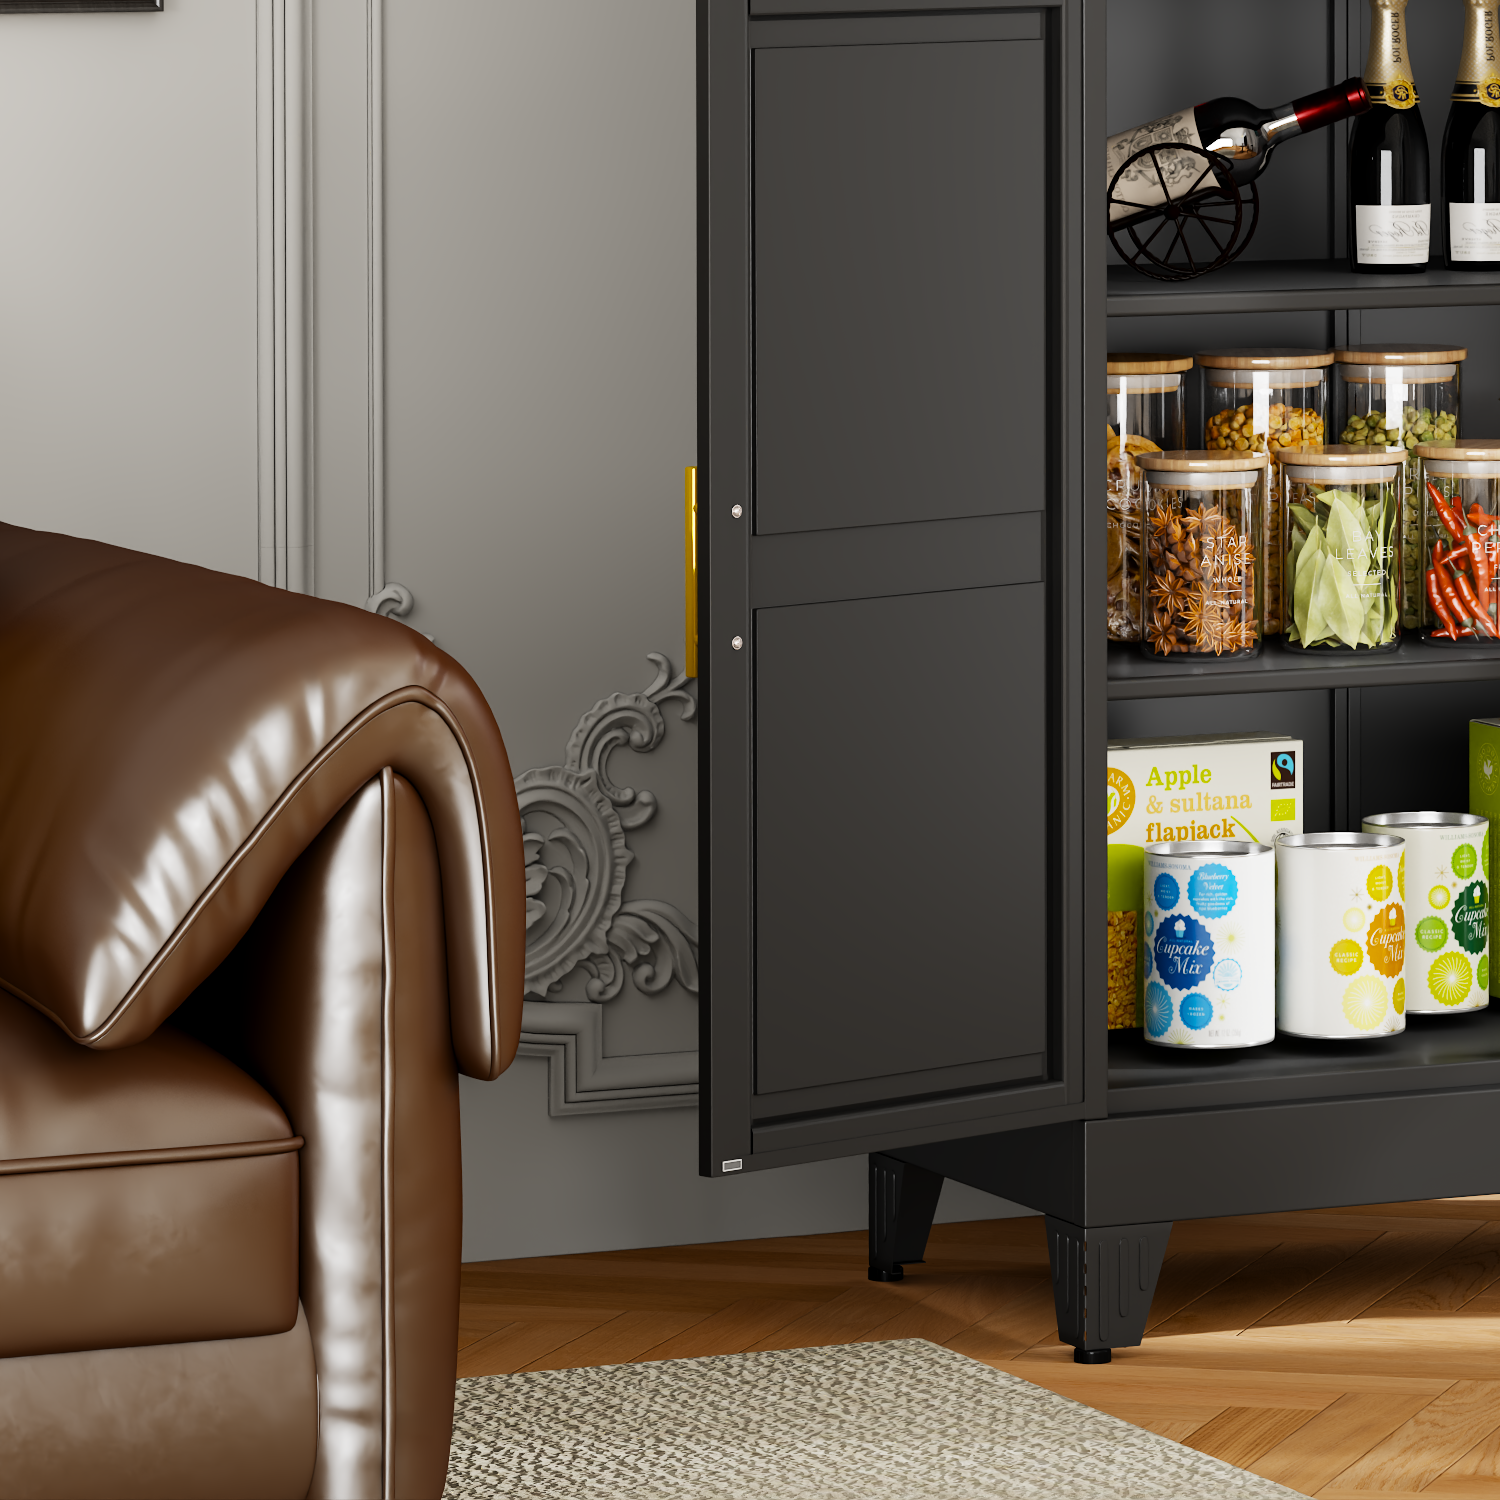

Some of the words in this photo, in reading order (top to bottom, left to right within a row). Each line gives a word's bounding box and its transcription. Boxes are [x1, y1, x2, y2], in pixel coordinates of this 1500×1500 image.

[1206, 536, 1247, 549] STAR
[1352, 529, 1384, 543] BAY
[1201, 553, 1252, 567] ANISE
[1335, 546, 1394, 560] LEAVES
[1347, 569, 1387, 577] SELECTED
[1107, 772, 1131, 797] ARM
[1145, 764, 1212, 792] Apple
[1146, 794, 1164, 815] &
[1170, 792, 1253, 814] sultana
[1145, 818, 1236, 843] flapjack
[1156, 936, 1210, 959] Cupcake
[1168, 956, 1203, 975] Mix
